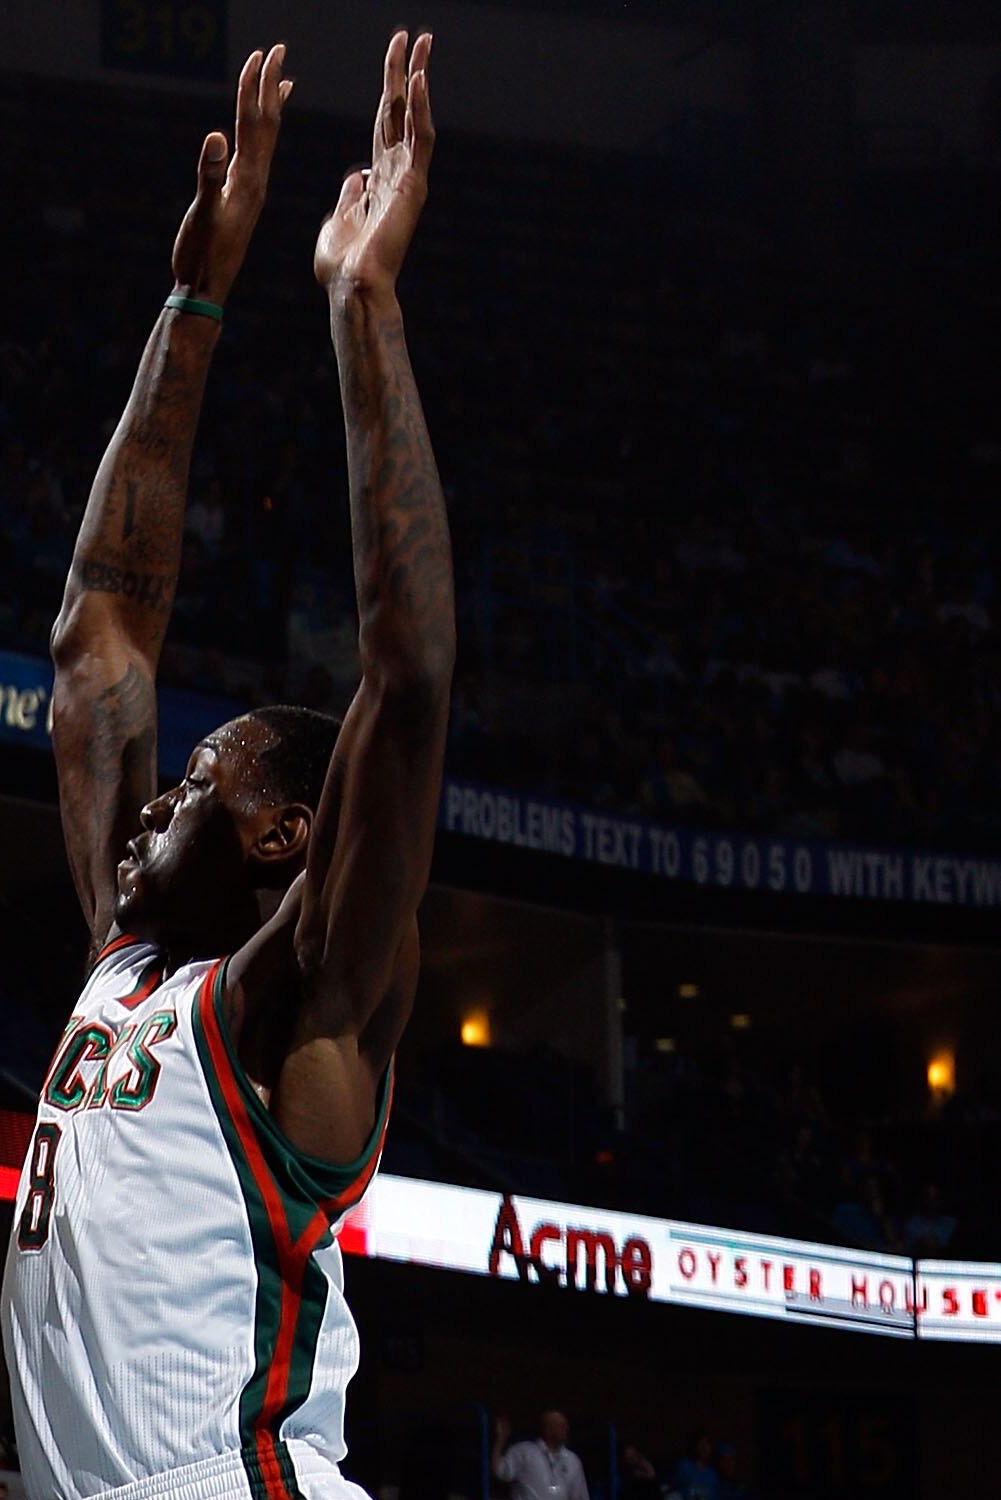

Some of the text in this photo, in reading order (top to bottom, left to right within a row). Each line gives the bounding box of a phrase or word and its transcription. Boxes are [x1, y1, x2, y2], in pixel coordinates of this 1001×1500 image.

[444, 783, 575, 858] PROBLEMS
[580, 812, 643, 871] TEXT
[648, 826, 682, 879] TO
[826, 848, 904, 902] WITH
[489, 1192, 990, 1319] Acme OYSTER HOUSE
